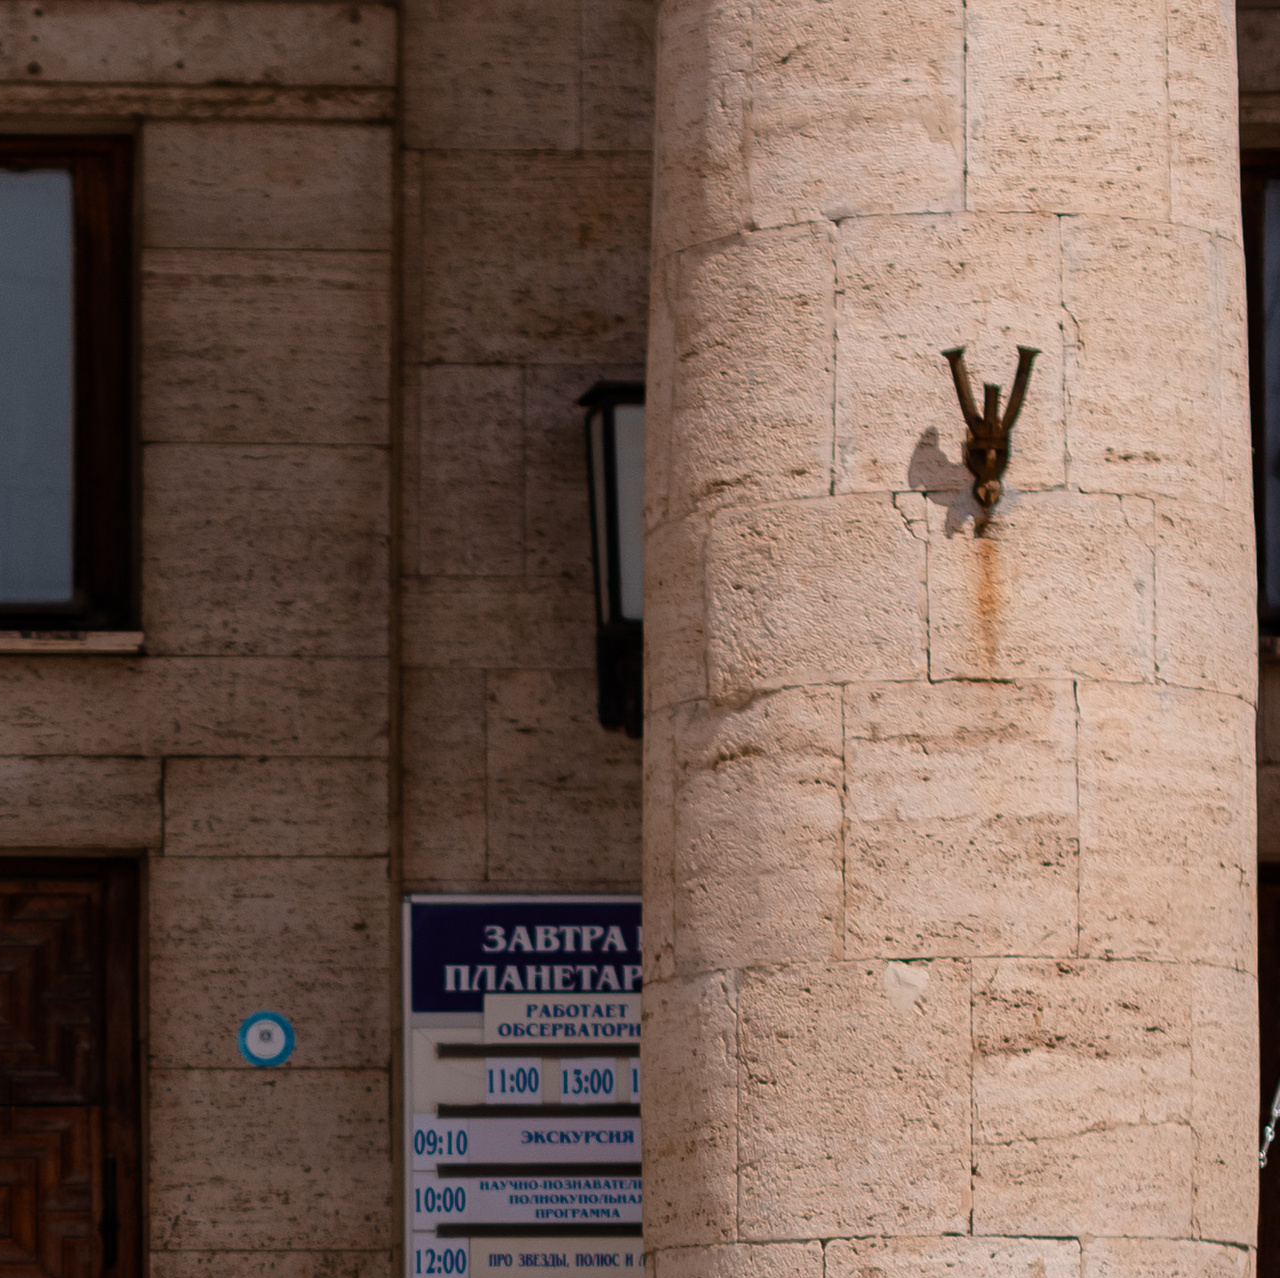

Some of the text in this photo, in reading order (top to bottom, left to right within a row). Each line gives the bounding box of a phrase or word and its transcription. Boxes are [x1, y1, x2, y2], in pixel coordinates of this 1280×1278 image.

[482, 925, 628, 953] ЗАВТРА
[525, 1004, 629, 1018] РАБОТАЕТ
[487, 1067, 539, 1094] 11:00
[562, 1068, 614, 1094] 13:00
[413, 1130, 634, 1156] 09:10 ЭКСКУРСИЯ
[415, 1187, 466, 1213] 10:00
[535, 1208, 620, 1219] ПРОГРАММА
[415, 1249, 466, 1274] 12:00
[489, 1254, 512, 1268] ПРО
[518, 1254, 569, 1268] ЗВЕЗДЫ,
[575, 1253, 620, 1268] ПОЛЮС
[625, 1253, 634, 1268] И
